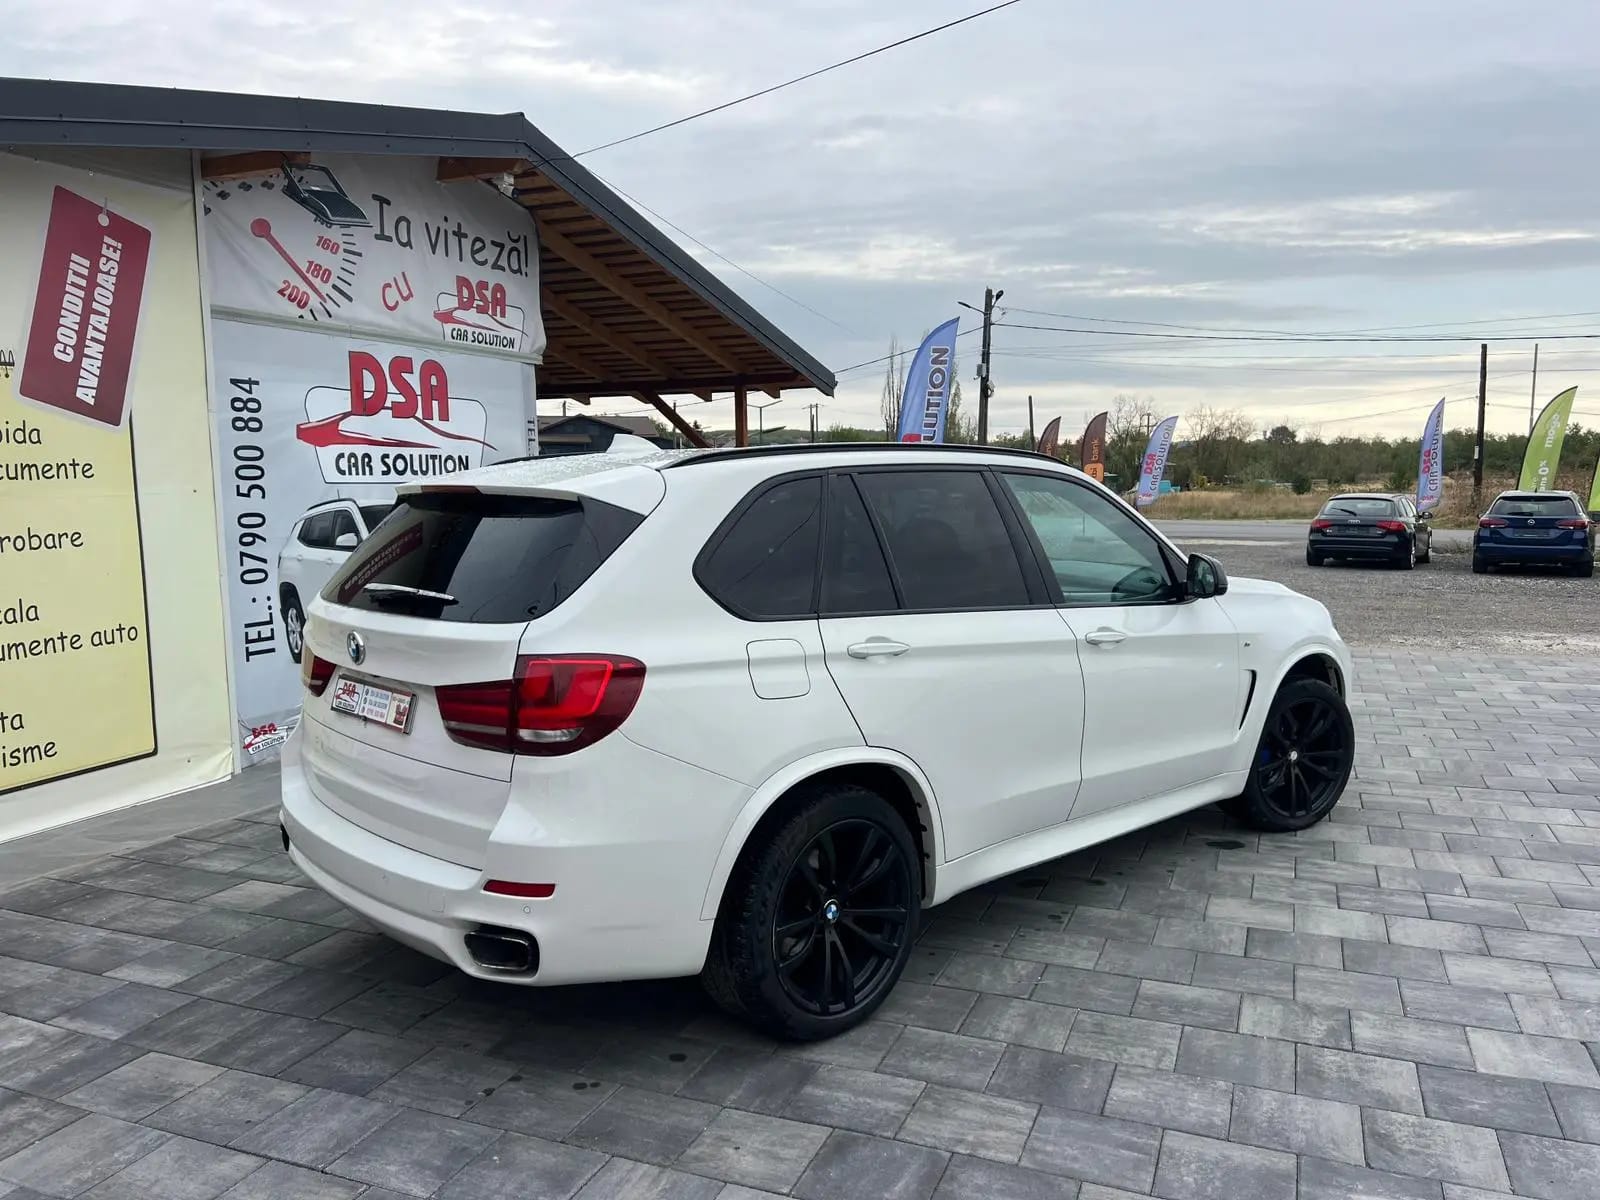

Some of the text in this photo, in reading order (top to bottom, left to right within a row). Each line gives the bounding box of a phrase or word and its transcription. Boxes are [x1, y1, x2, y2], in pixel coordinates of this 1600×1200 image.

[315, 235, 341, 256] 160
[371, 193, 529, 278] Ia viteză!
[305, 259, 333, 285] 180
[53, 252, 90, 364] CONDITII
[277, 279, 311, 310] 200
[455, 275, 508, 319] DSA
[76, 234, 123, 406] AVANTAJOASE!
[450, 327, 516, 350] CAR SOLUTION
[229, 376, 263, 433] 884
[348, 350, 450, 422] DSA
[233, 445, 266, 500] 500
[334, 453, 470, 478] CAR SOLUTION
[236, 511, 269, 586] 0790
[0, 598, 40, 625] ala
[91, 623, 138, 648] auto
[2, 741, 58, 769] isme
